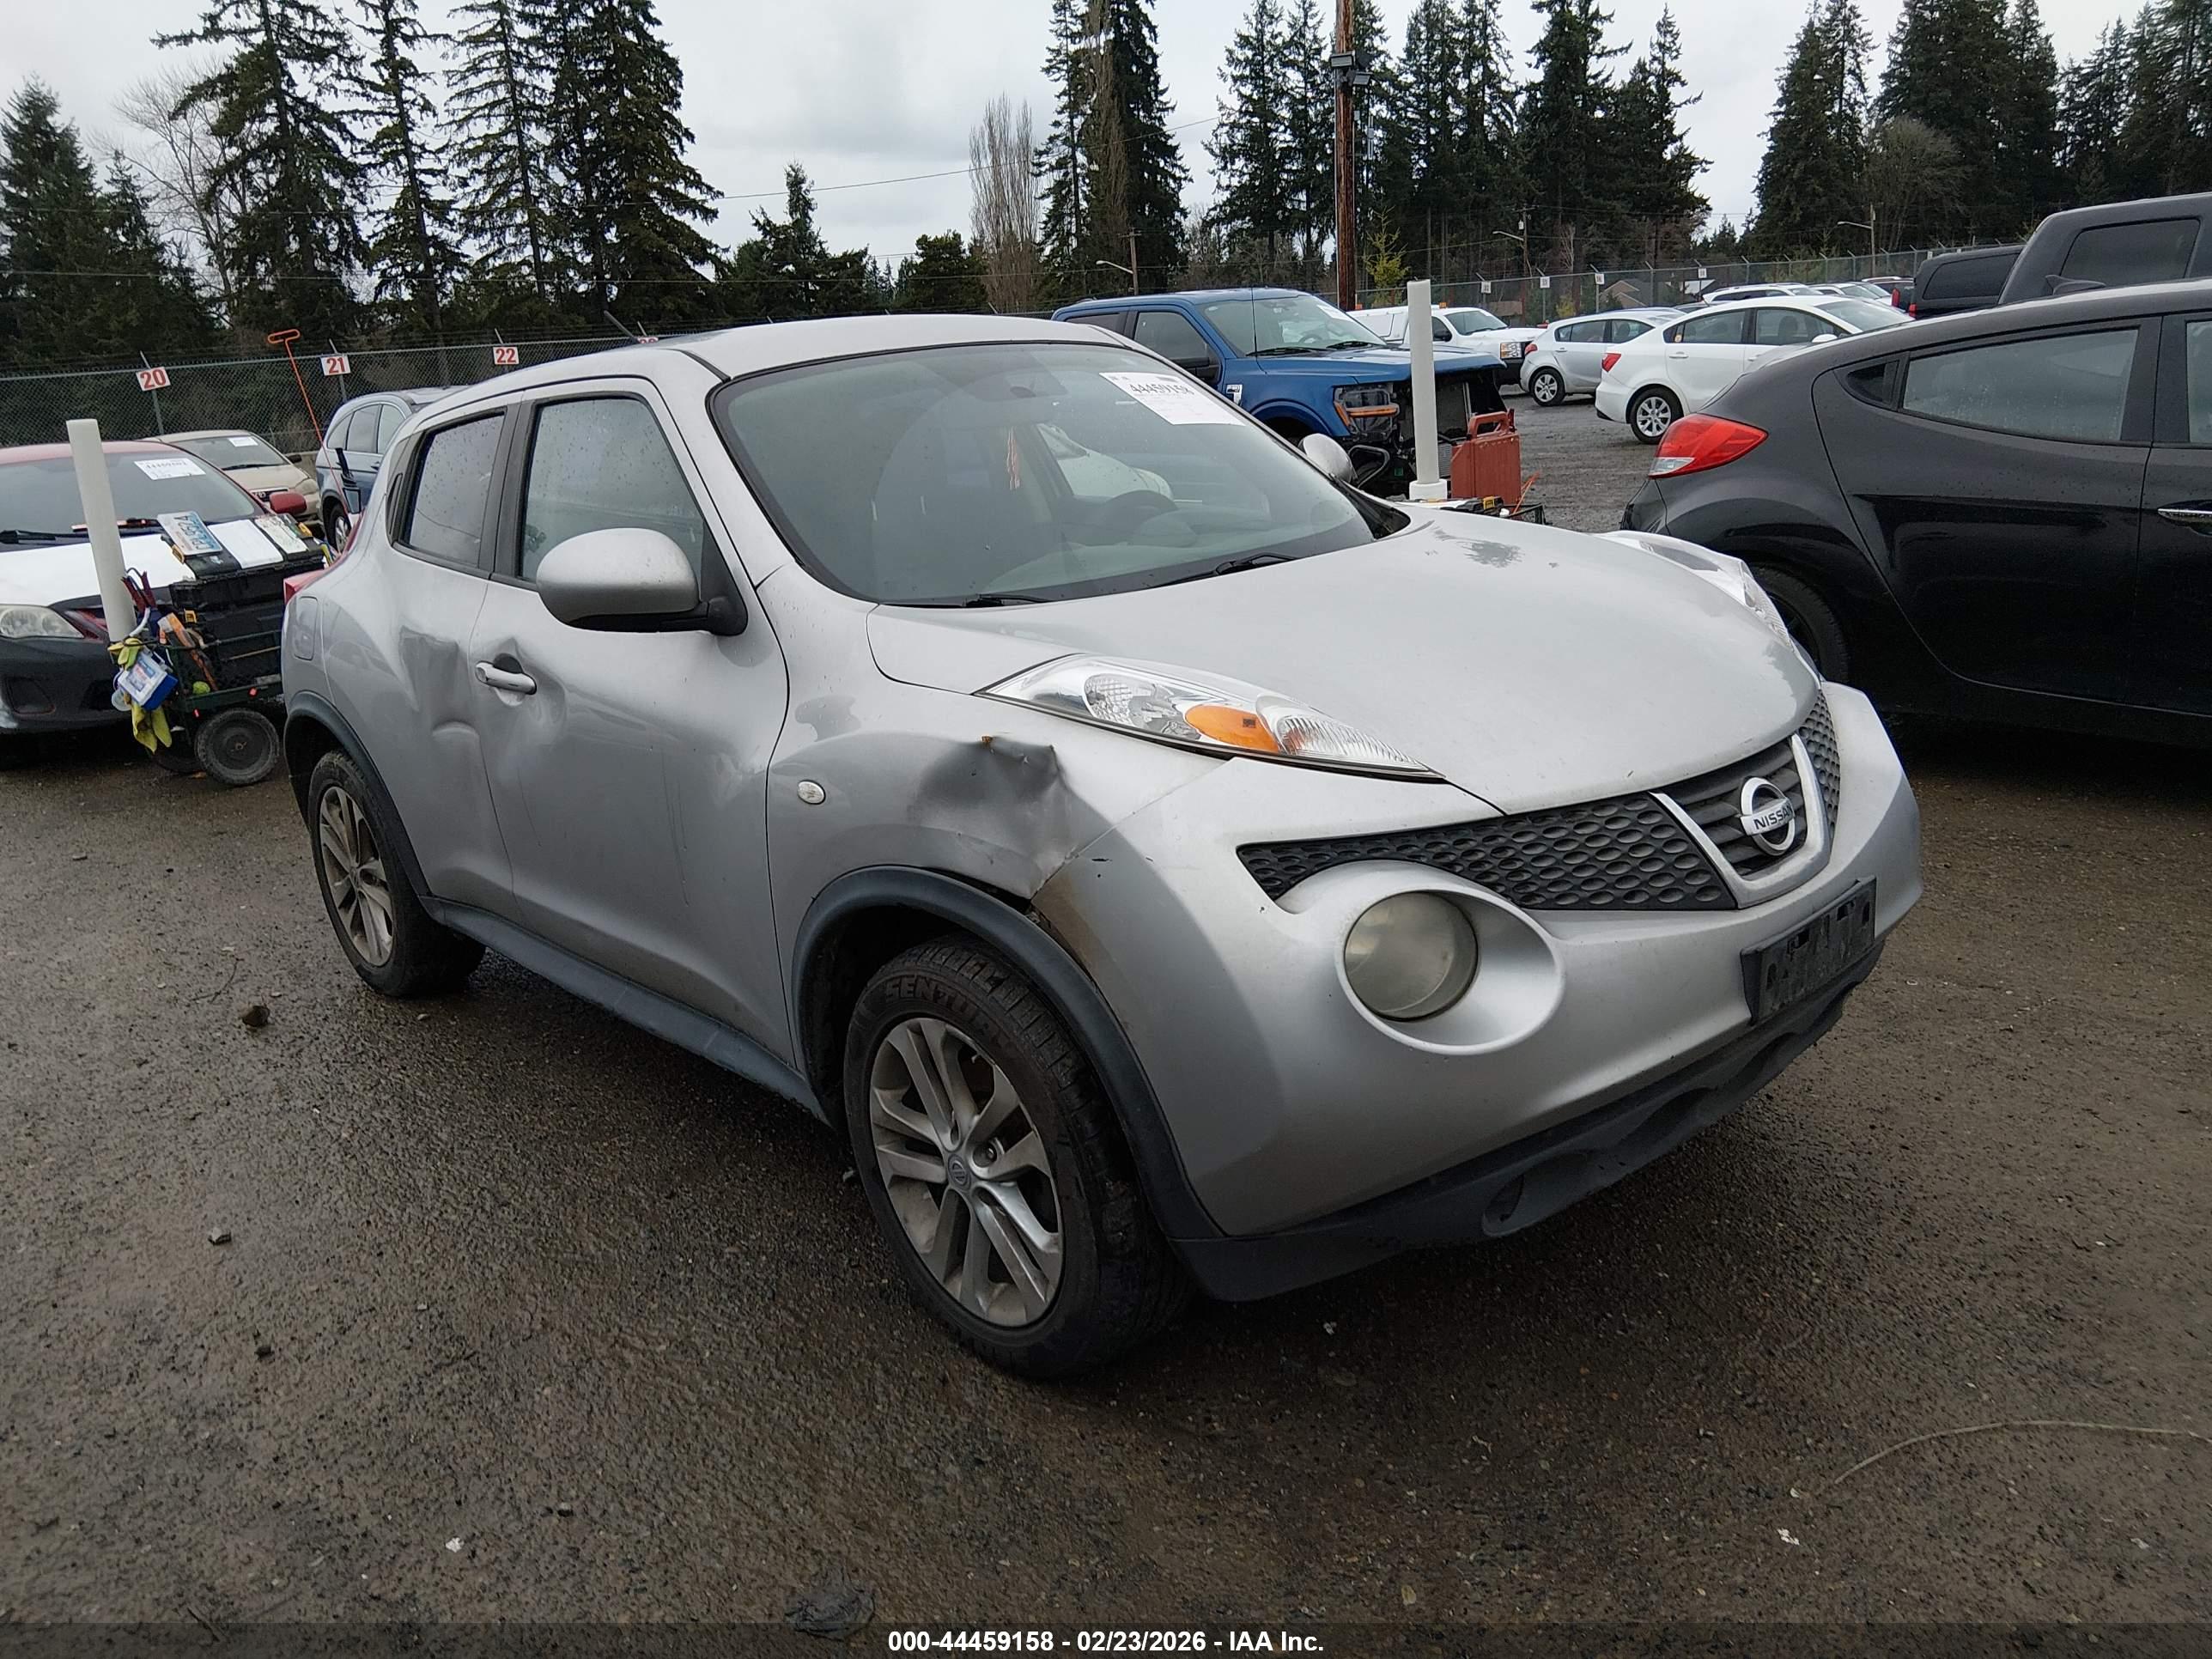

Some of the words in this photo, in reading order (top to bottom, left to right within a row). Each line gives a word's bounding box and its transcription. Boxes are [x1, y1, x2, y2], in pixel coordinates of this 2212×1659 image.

[495, 348, 516, 363] 22
[326, 357, 345, 374] 21
[140, 369, 166, 389] 20
[1753, 805, 1793, 830] NISSAN
